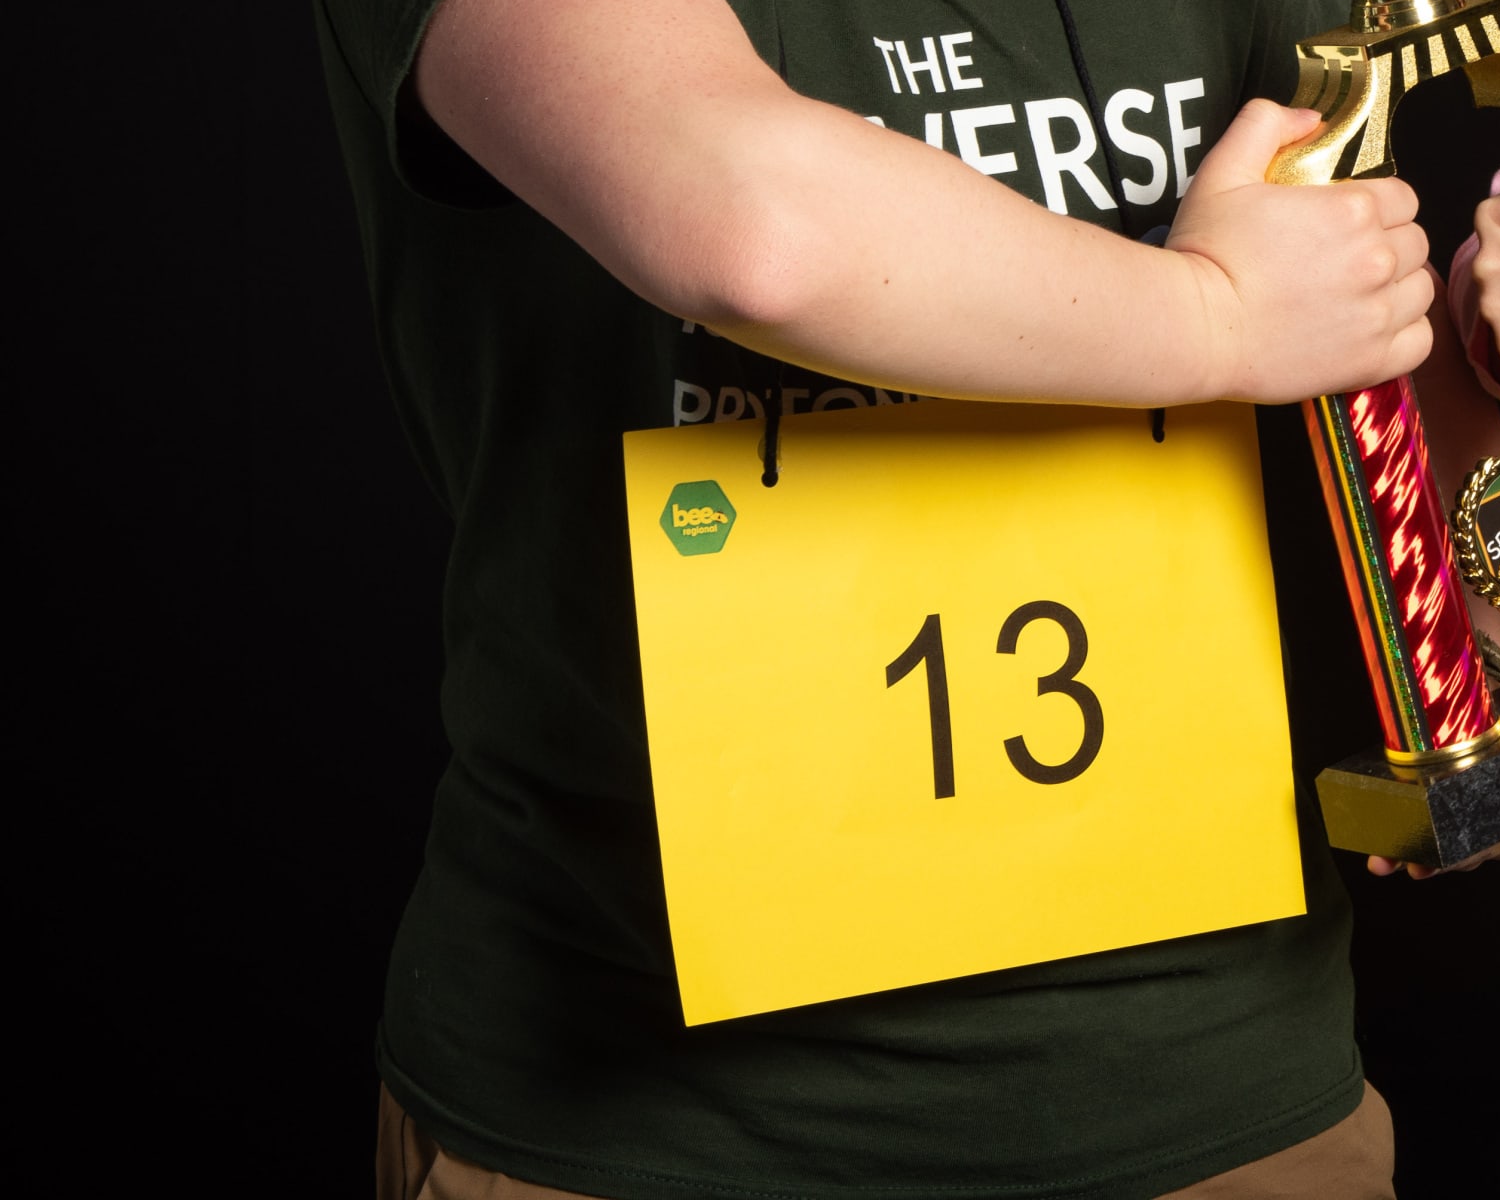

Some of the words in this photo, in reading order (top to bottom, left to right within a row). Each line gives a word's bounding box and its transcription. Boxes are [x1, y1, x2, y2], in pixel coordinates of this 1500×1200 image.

[872, 31, 984, 95] THE
[672, 503, 714, 528] bee
[682, 524, 718, 537] regional
[885, 599, 1105, 800] 13
